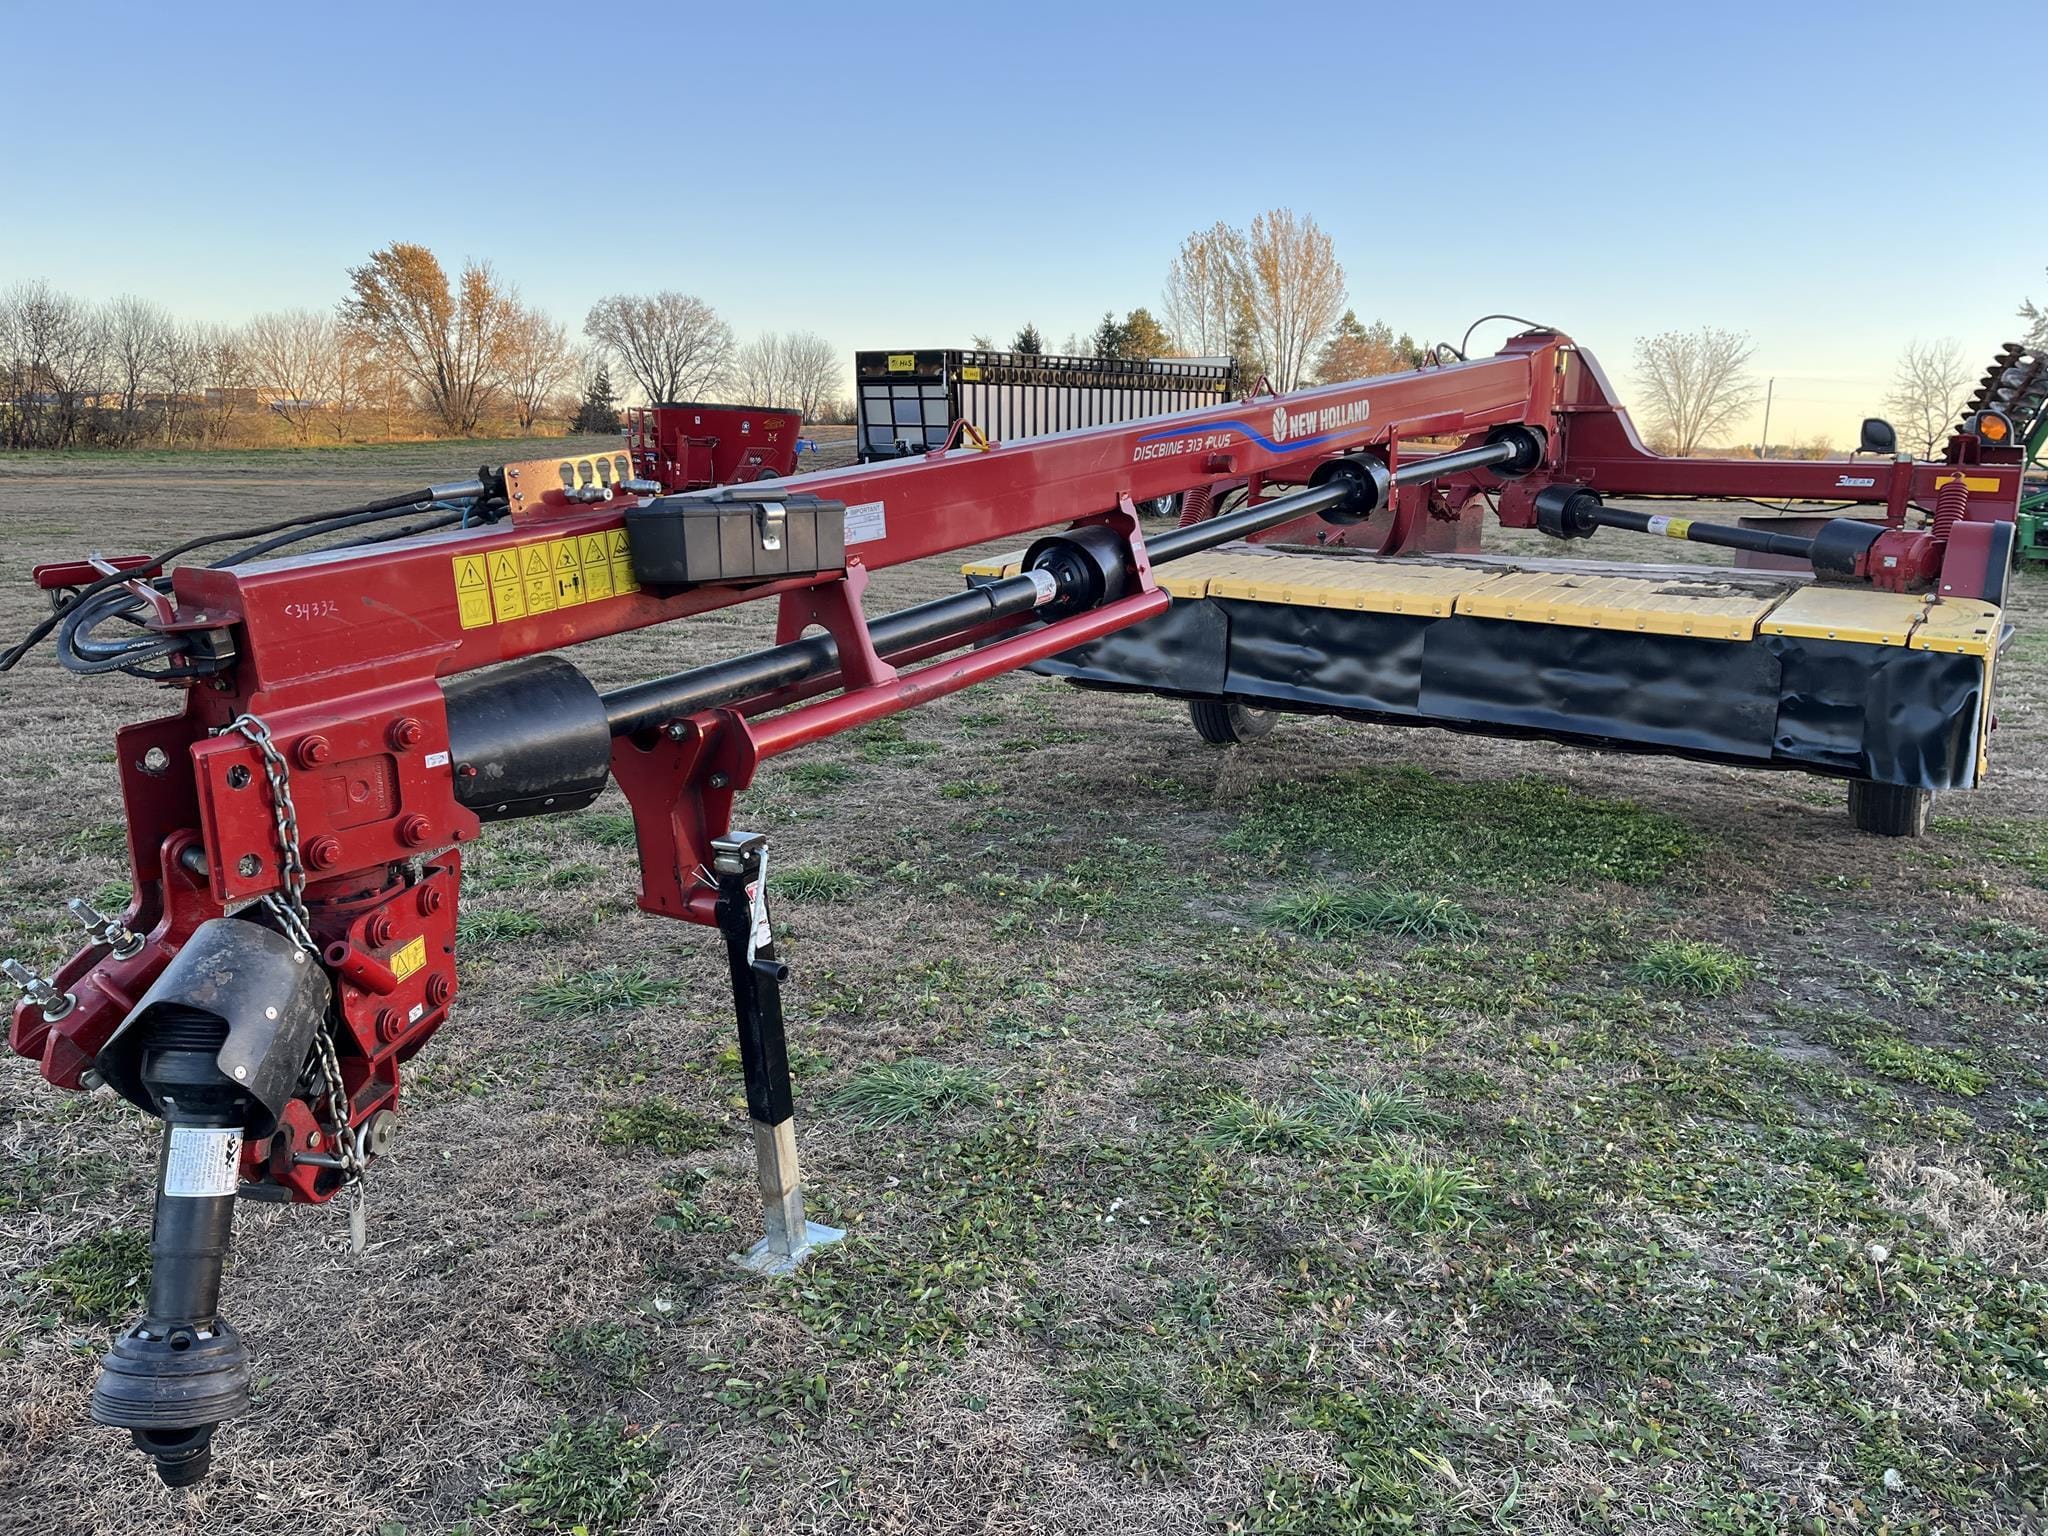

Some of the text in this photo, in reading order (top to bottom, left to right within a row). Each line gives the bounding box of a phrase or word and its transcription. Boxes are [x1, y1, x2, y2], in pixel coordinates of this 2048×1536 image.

[1289, 399, 1370, 438] NEW HOLLAND
[1133, 433, 1231, 461] DISCBINE 313 PLUS
[284, 600, 339, 621] C34332
